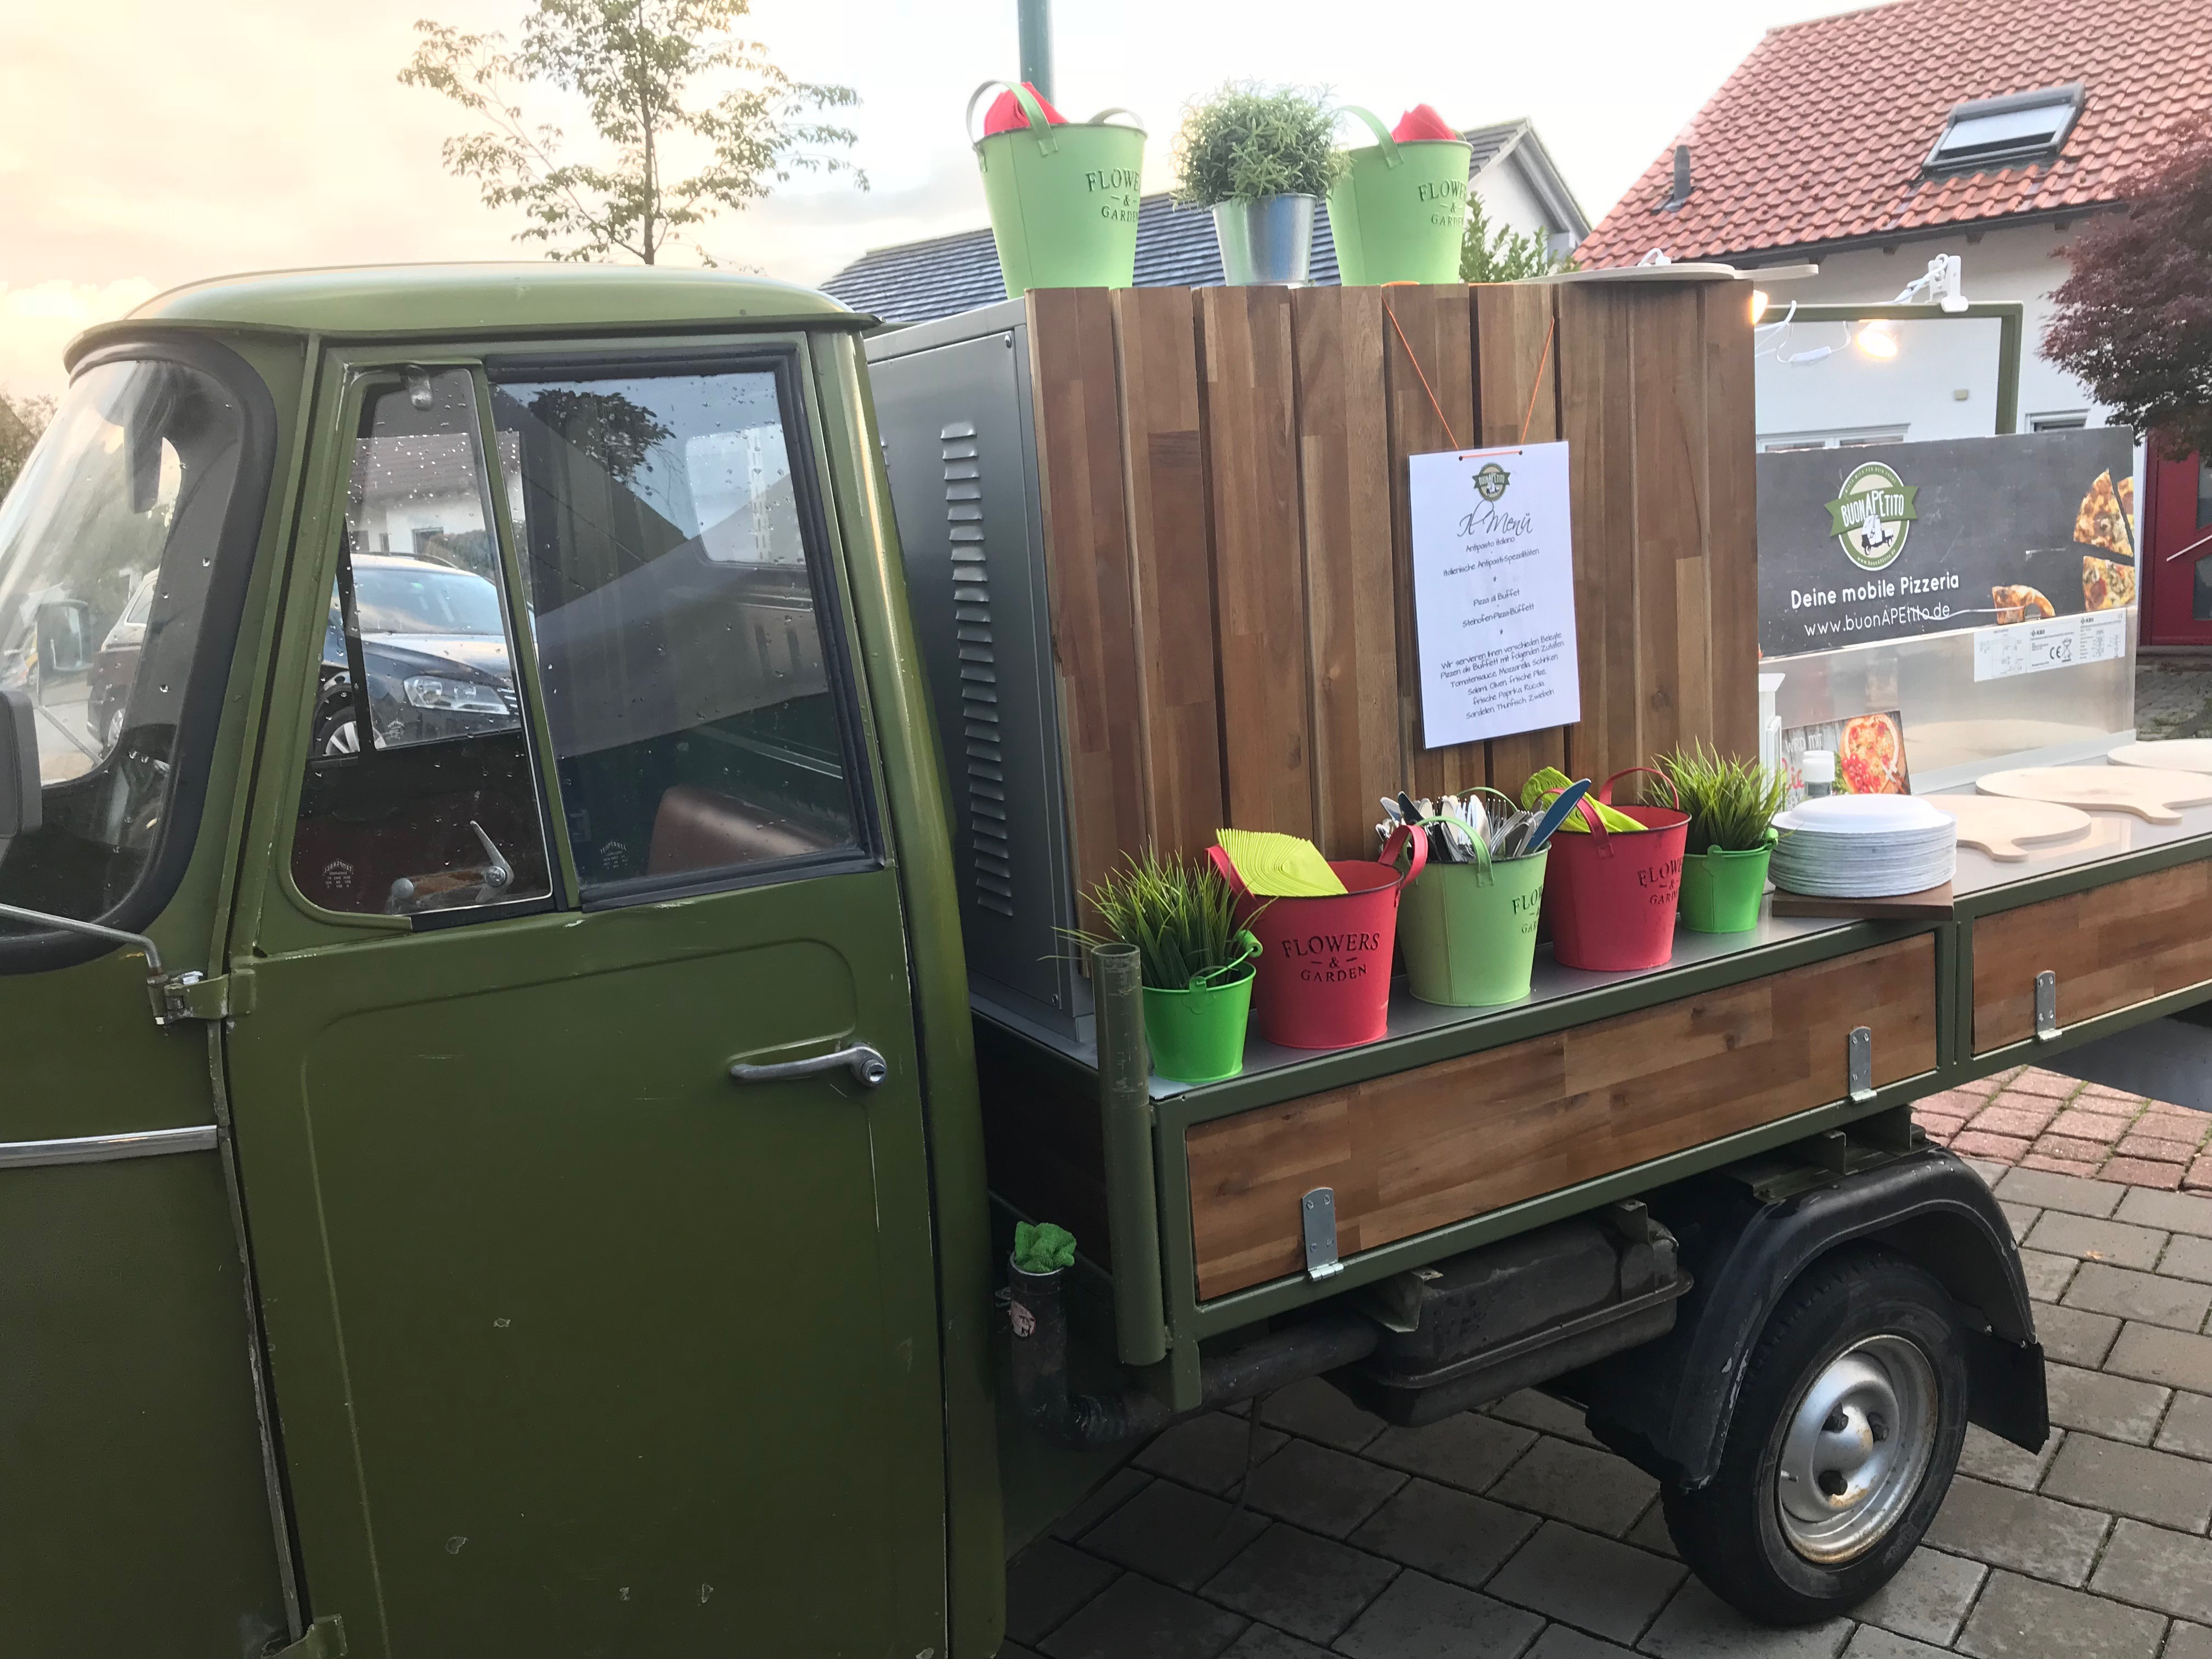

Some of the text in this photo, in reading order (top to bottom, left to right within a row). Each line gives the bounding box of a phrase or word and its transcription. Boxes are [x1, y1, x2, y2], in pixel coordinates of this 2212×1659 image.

[1085, 167, 1141, 192] FLOWE
[1482, 510, 1533, 536] Menü
[1465, 540, 1495, 554] Antipasto
[1443, 563, 1476, 577] Italienische
[1474, 597, 1489, 607] Pizza
[1497, 588, 1520, 601] Buffet
[1791, 571, 1960, 610] Deine mobile Pizzeria
[1441, 660, 1454, 669] Wir
[1455, 653, 1486, 666] servieren
[1487, 648, 1503, 658] Ihnen
[1541, 632, 1562, 644] Belegte
[1440, 669, 1461, 679] Pizzen
[1463, 665, 1471, 674] als
[1500, 654, 1509, 663] mit
[1511, 646, 1540, 662] folgenden
[1509, 673, 1532, 684] frische
[1472, 693, 1497, 706] frische
[1785, 736, 1806, 753] WIRD
[1650, 889, 1677, 905] GARD
[1281, 932, 1380, 958] FLOWERS
[1329, 956, 1340, 968] &
[1300, 964, 1367, 982] GARDEN
